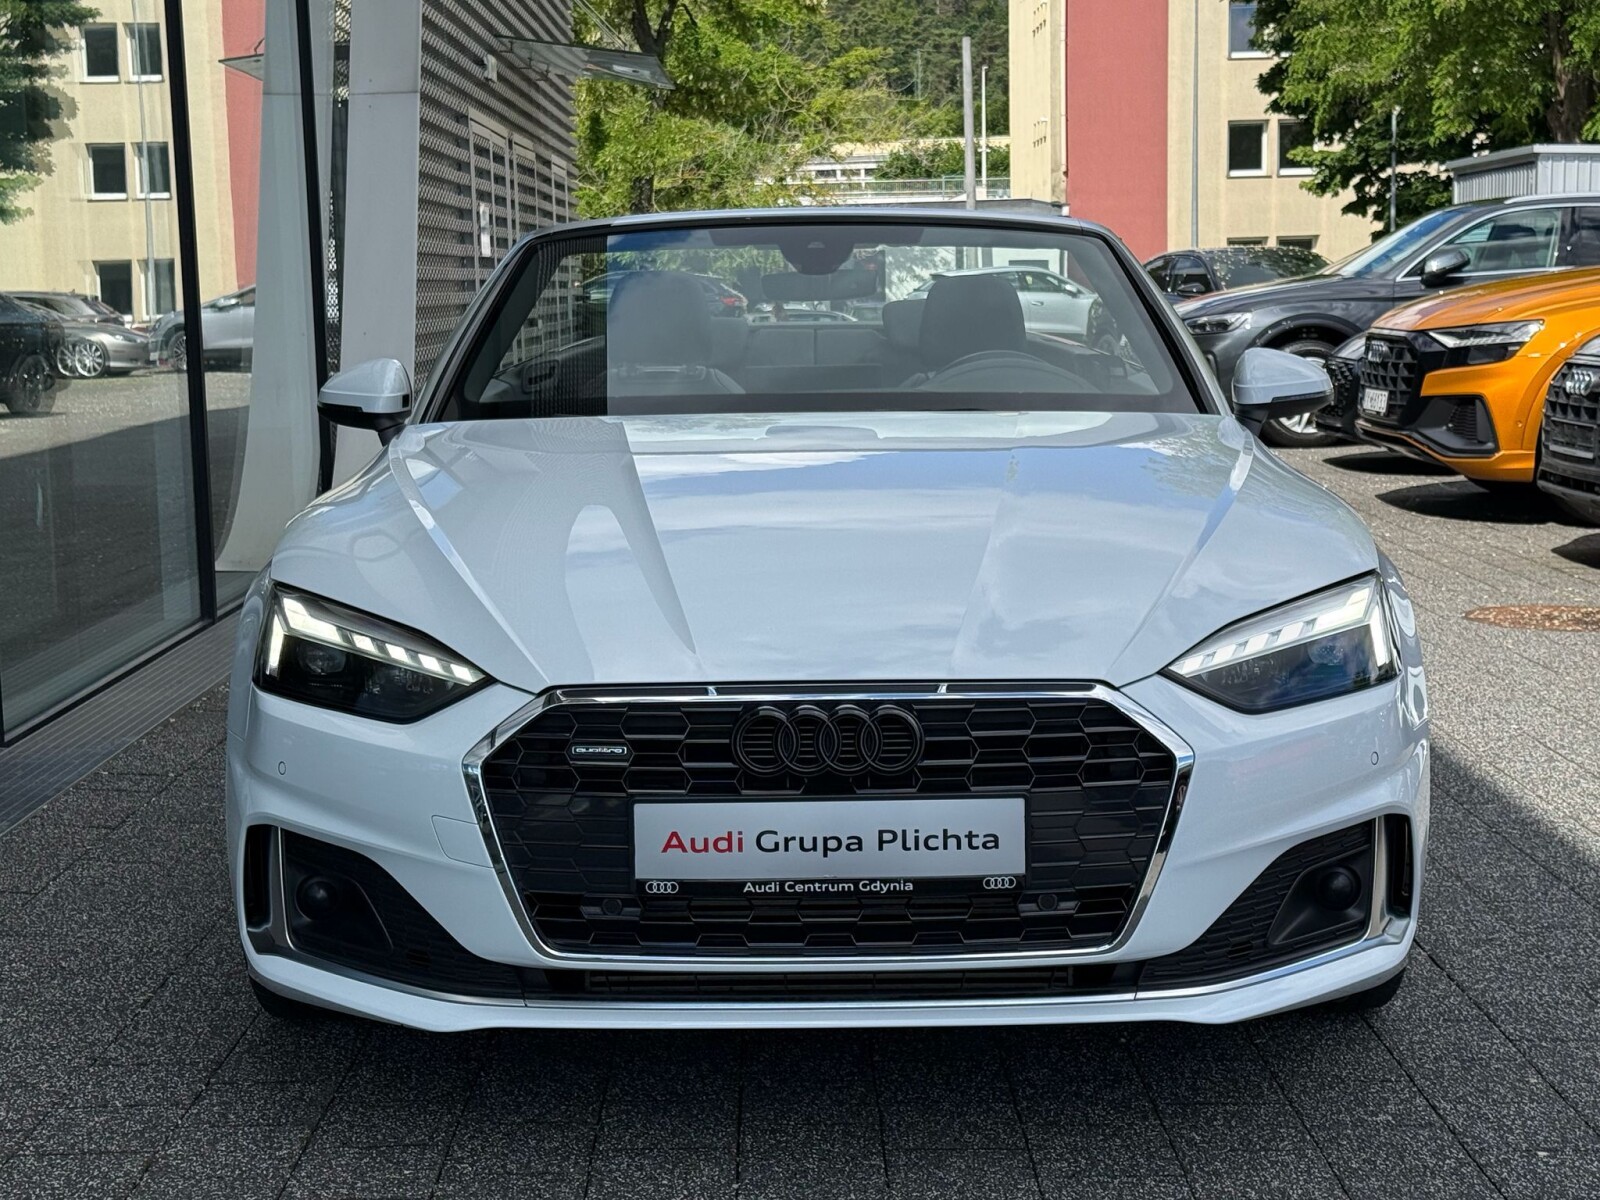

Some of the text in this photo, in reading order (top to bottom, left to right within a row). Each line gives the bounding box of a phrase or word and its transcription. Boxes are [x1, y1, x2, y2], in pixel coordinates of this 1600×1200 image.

[661, 828, 1000, 858] Audi Grupa Plichta
[743, 880, 914, 894] Audi Centrum Gdynia
